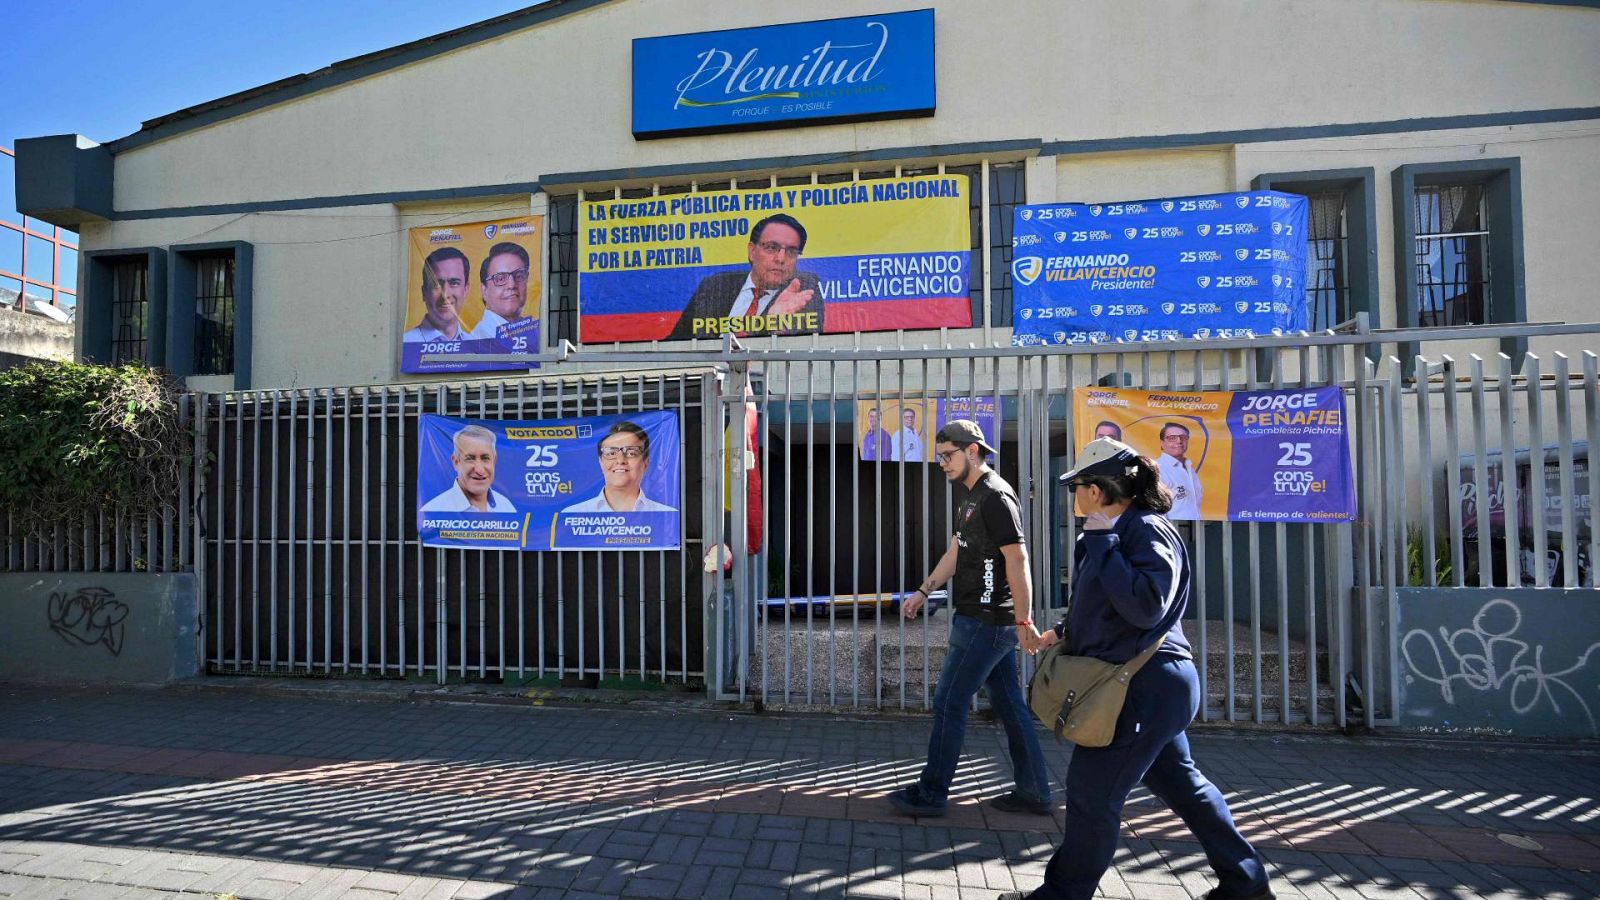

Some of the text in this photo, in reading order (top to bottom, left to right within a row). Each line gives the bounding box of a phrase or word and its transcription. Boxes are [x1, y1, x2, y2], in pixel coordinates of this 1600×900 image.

[674, 22, 888, 110] Plenitud
[732, 106, 769, 117] PORQUE
[781, 104, 793, 113] ES
[795, 101, 832, 112] POSIBLE
[588, 179, 959, 221] LA FUERZA PÚBLICA FFAA Y POLICÍA NACIONAL
[1255, 196, 1272, 207] 25
[1107, 205, 1123, 215] 25
[1180, 201, 1196, 212] 25
[1038, 209, 1053, 219] 25
[588, 218, 749, 245] EN SERVICIO PASIVO
[1143, 228, 1158, 238] 25
[1216, 224, 1232, 235] 25
[1072, 232, 1087, 242] 25
[588, 247, 702, 269] POR LA PATRIA
[1180, 252, 1196, 262] 25
[1255, 249, 1271, 260] 25
[858, 255, 962, 277] FERNANDO
[1046, 254, 1129, 269] FERNANDO
[1045, 266, 1155, 282] VILLAVICENCIO
[818, 275, 962, 299] VILLAVICENCIO
[1091, 279, 1155, 290] Presidente!
[1216, 277, 1232, 287] 25
[1038, 308, 1053, 318] 25
[1108, 305, 1124, 315] 25
[1180, 304, 1196, 314] 25
[1254, 302, 1271, 313] 25
[692, 312, 818, 334] PRESIDENTE
[420, 343, 461, 353] JORGE
[512, 337, 527, 349] 25
[1148, 394, 1202, 403] FERNANDO
[1241, 393, 1318, 410] JORGE
[1147, 401, 1218, 410] VILLAVICENCIO
[1243, 408, 1343, 427] PEÑAFIE
[540, 429, 573, 437] TODO
[526, 445, 559, 467] 25
[1276, 442, 1313, 466] 25
[526, 472, 560, 483] cons
[1274, 471, 1314, 482] cons
[526, 480, 573, 497] truye!
[1274, 479, 1327, 496] truye!
[565, 516, 625, 526] FERNANDO
[1238, 511, 1349, 520] ¡Es tiempo de valientes!
[422, 519, 519, 530] PATRICIO CARRILLO
[572, 526, 651, 536] VILLAVICENCIO
[980, 559, 994, 604] Ecuabet
